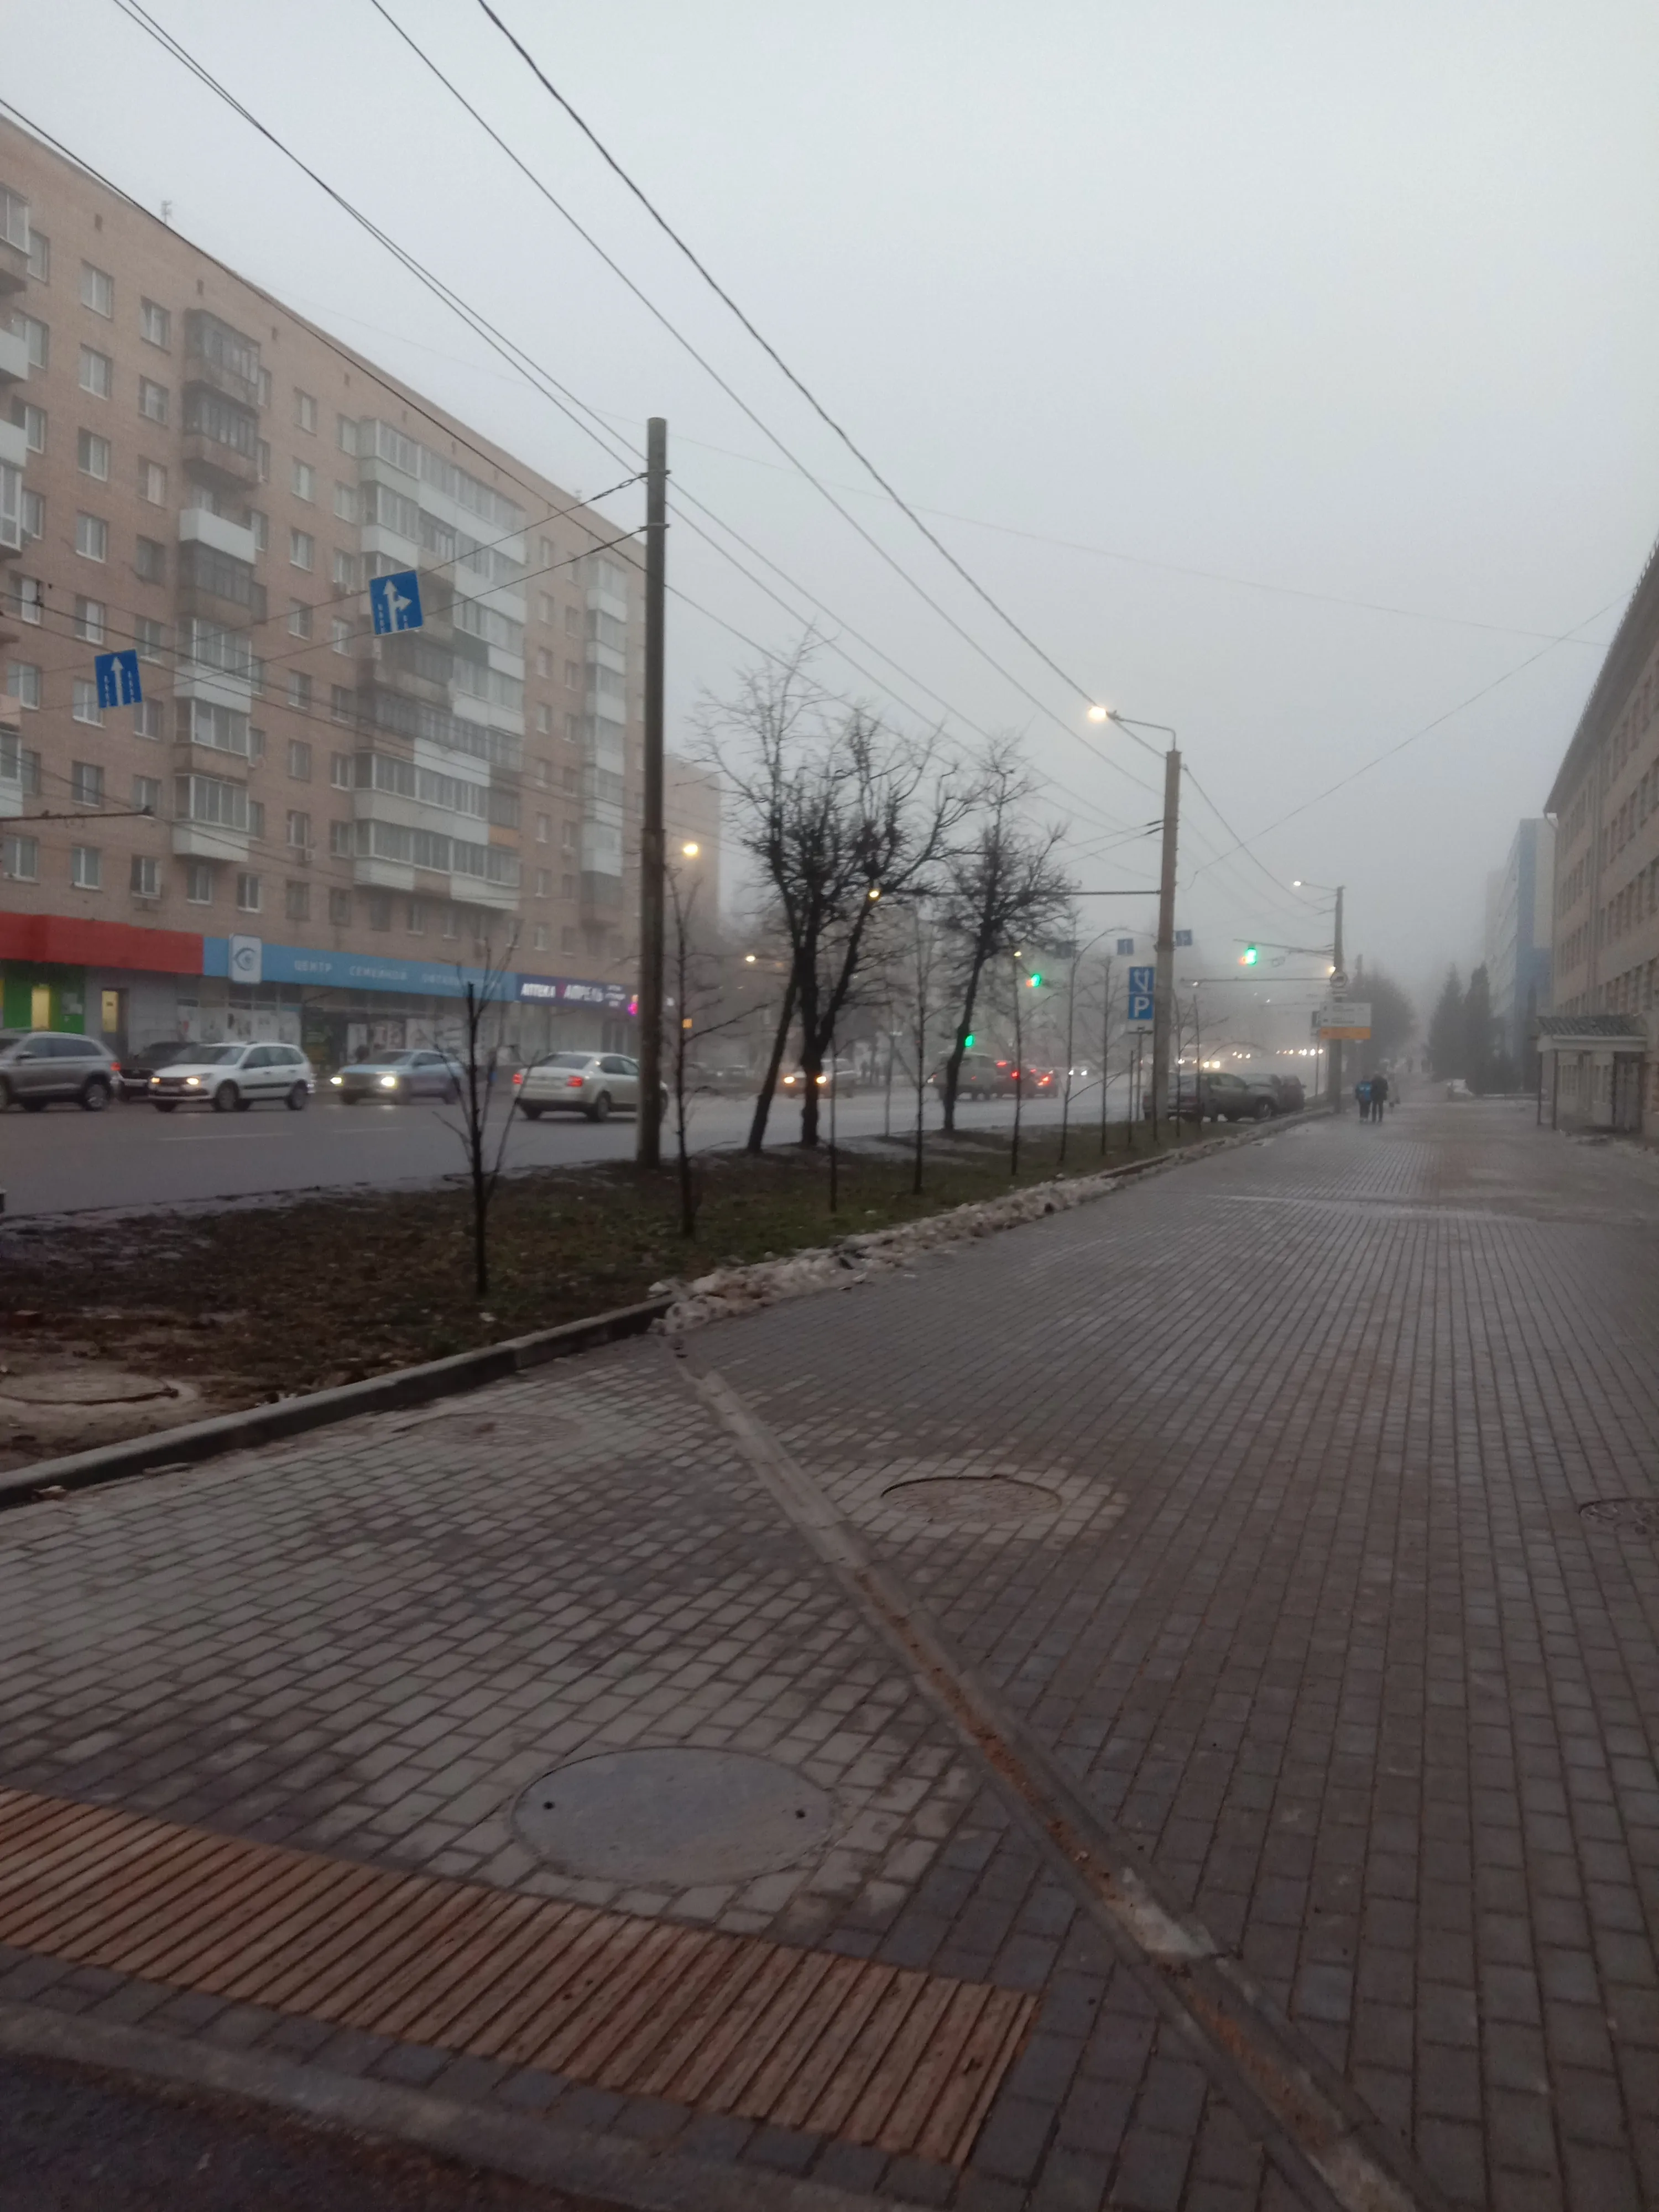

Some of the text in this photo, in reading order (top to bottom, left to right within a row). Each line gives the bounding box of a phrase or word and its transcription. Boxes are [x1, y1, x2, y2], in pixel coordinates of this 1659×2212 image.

[294, 960, 332, 972] ЦЕНТР
[520, 983, 556, 998] АПТЕКА
[1134, 997, 1150, 1018] P
